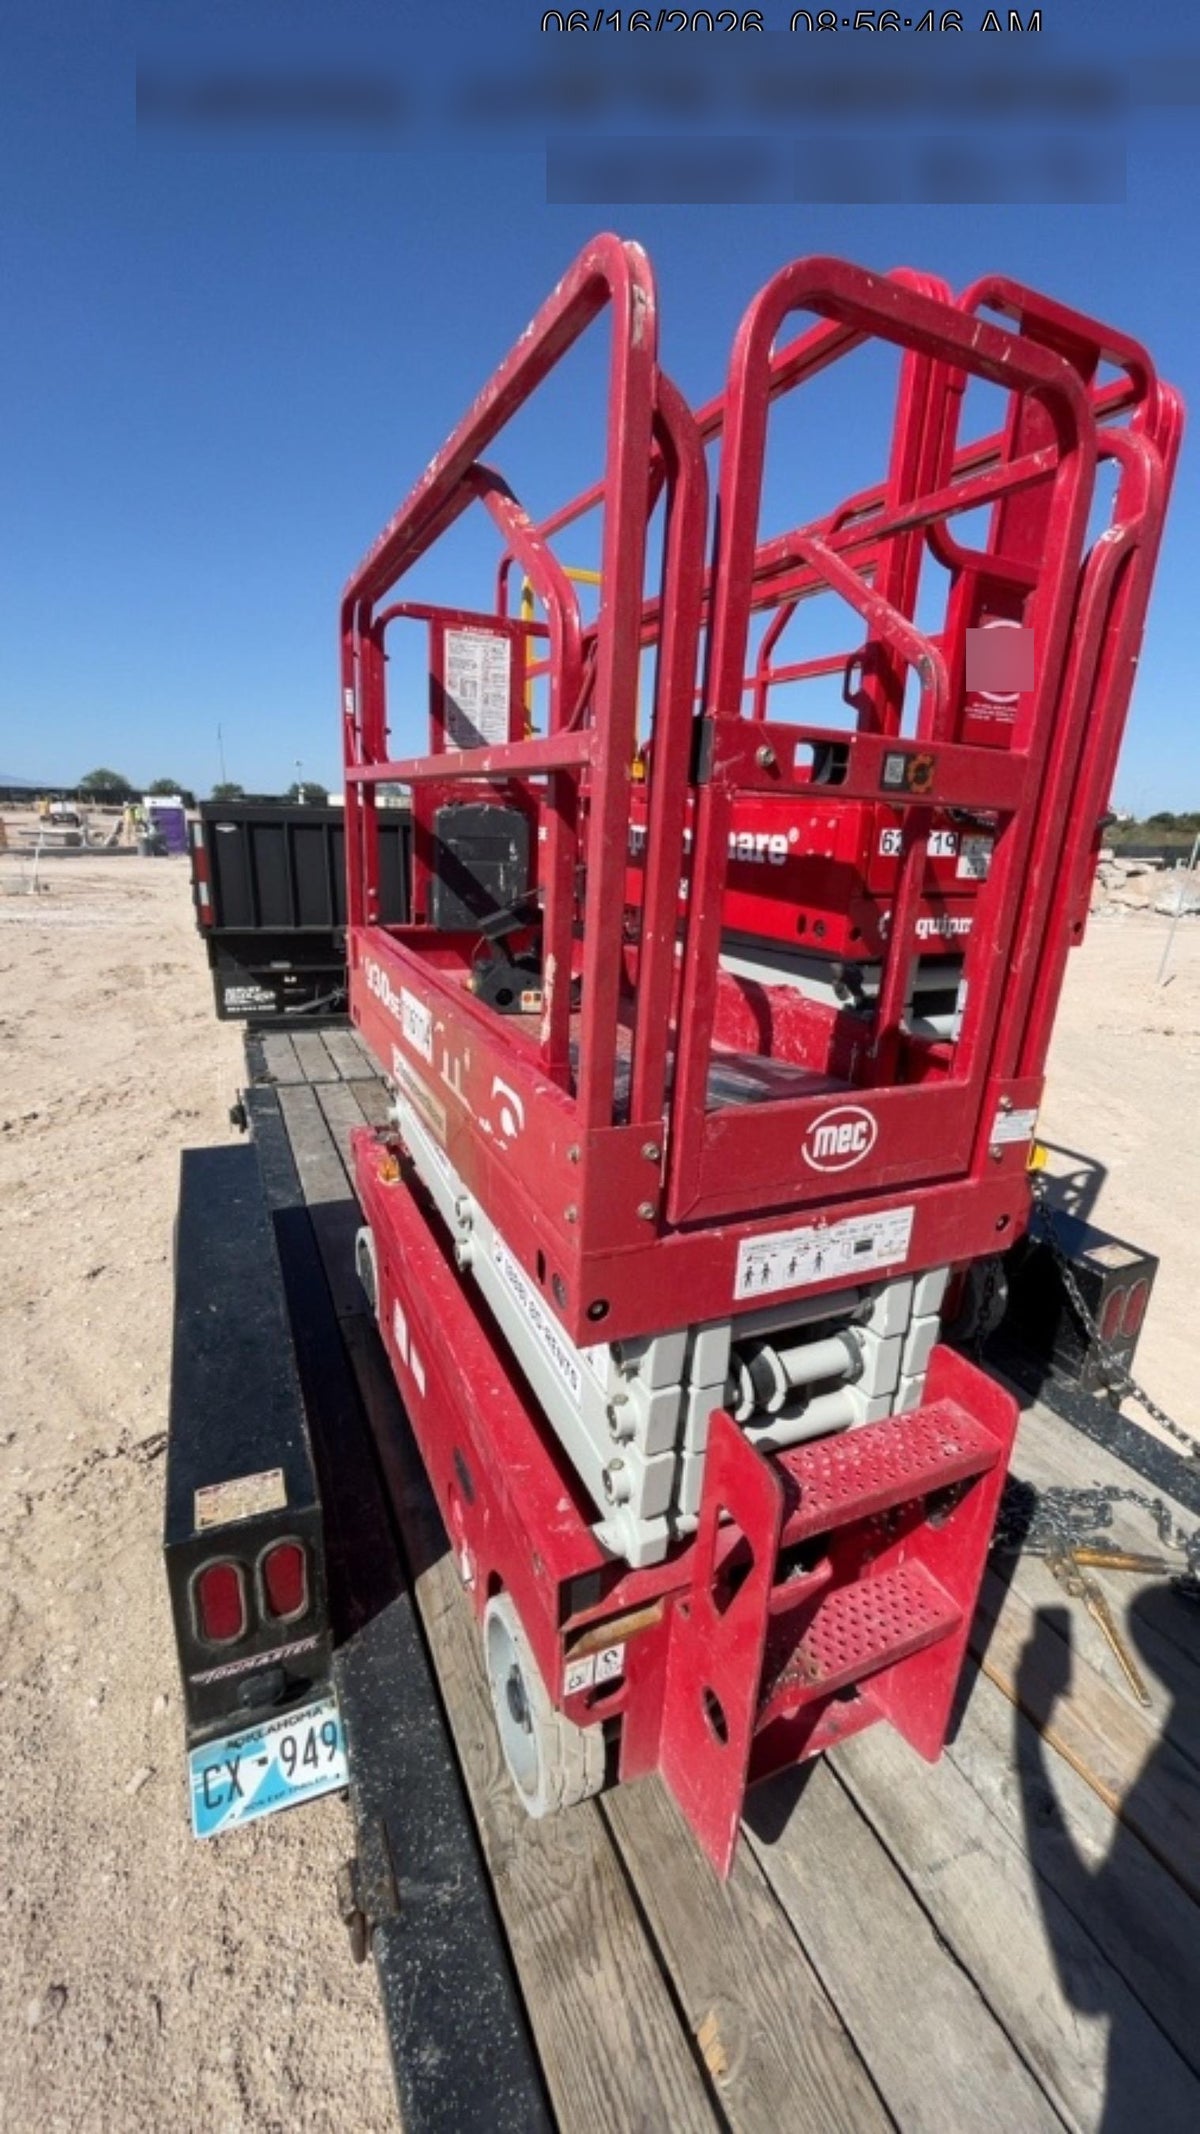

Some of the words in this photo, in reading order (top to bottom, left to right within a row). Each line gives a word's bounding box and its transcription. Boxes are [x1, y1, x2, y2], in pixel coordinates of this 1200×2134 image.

[227, 1706, 323, 1749] OKLAHOMA
[203, 1756, 244, 1810] CX
[280, 1720, 338, 1777] 949
